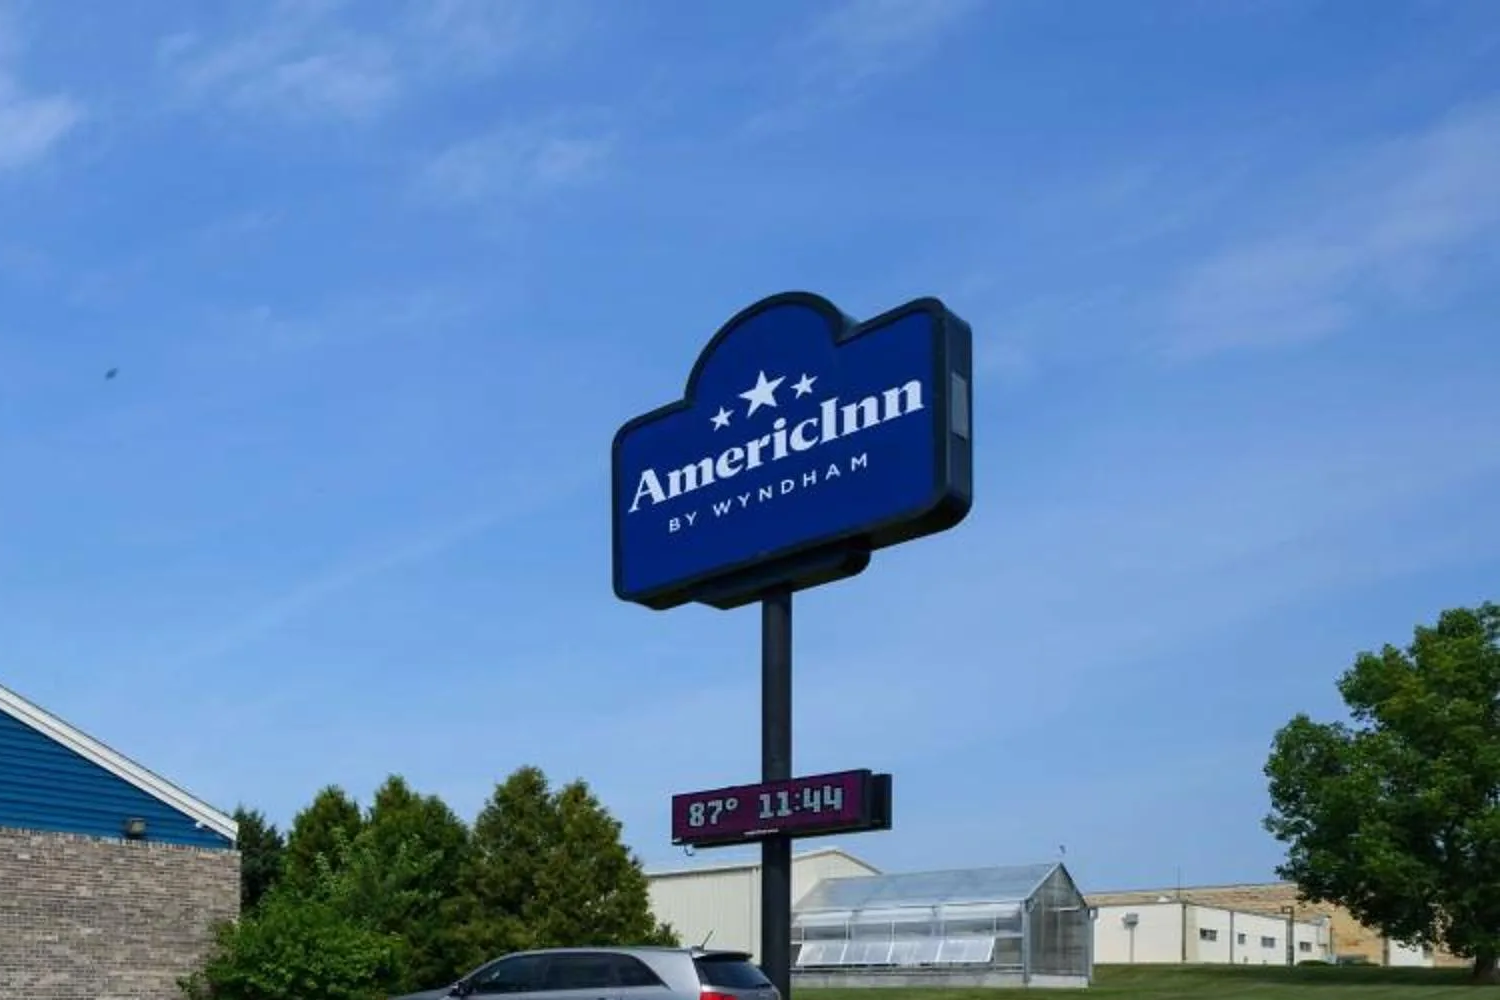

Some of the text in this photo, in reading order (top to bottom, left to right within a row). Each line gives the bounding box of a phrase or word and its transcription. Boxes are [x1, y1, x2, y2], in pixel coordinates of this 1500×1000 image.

[628, 379, 924, 512] AmericInn
[668, 453, 868, 533] BY WYNDHAM
[688, 785, 843, 827] 87° 11:44
